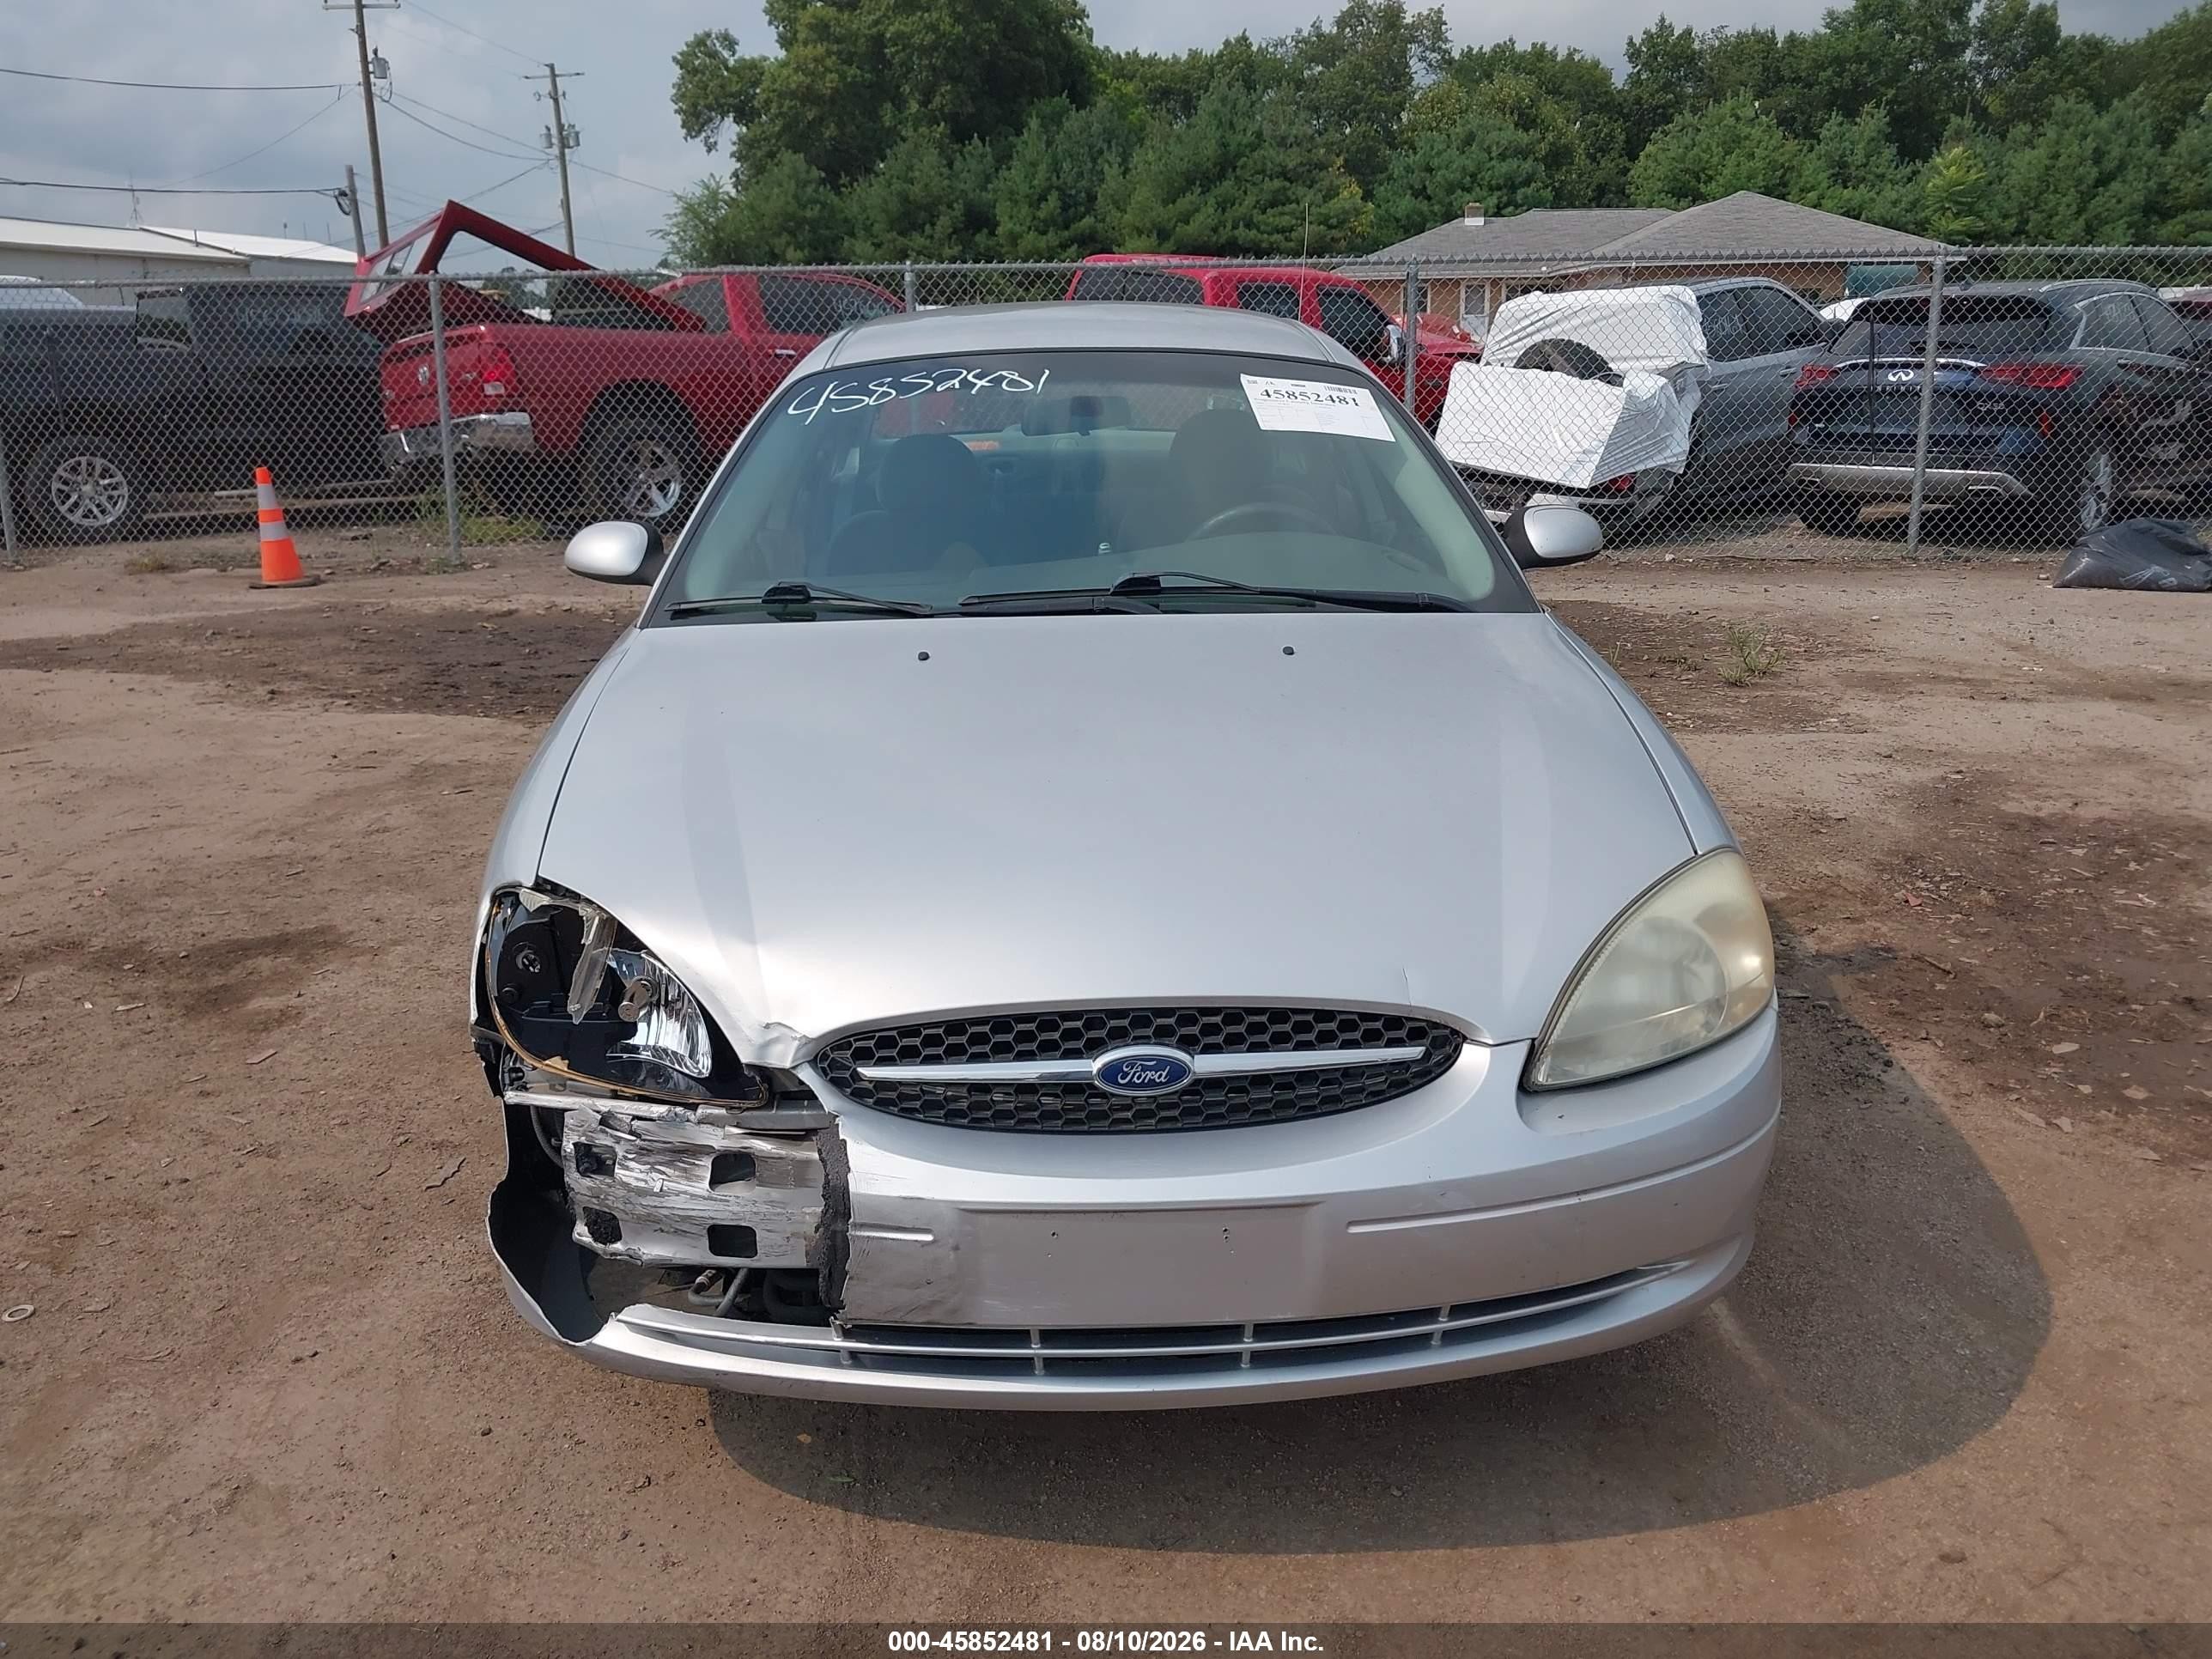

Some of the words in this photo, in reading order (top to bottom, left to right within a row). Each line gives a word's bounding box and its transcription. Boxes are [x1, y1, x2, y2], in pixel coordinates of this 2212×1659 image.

[787, 368, 1050, 425] 45852481
[1260, 388, 1360, 407] 45852481
[1117, 1060, 1170, 1085] Ford
